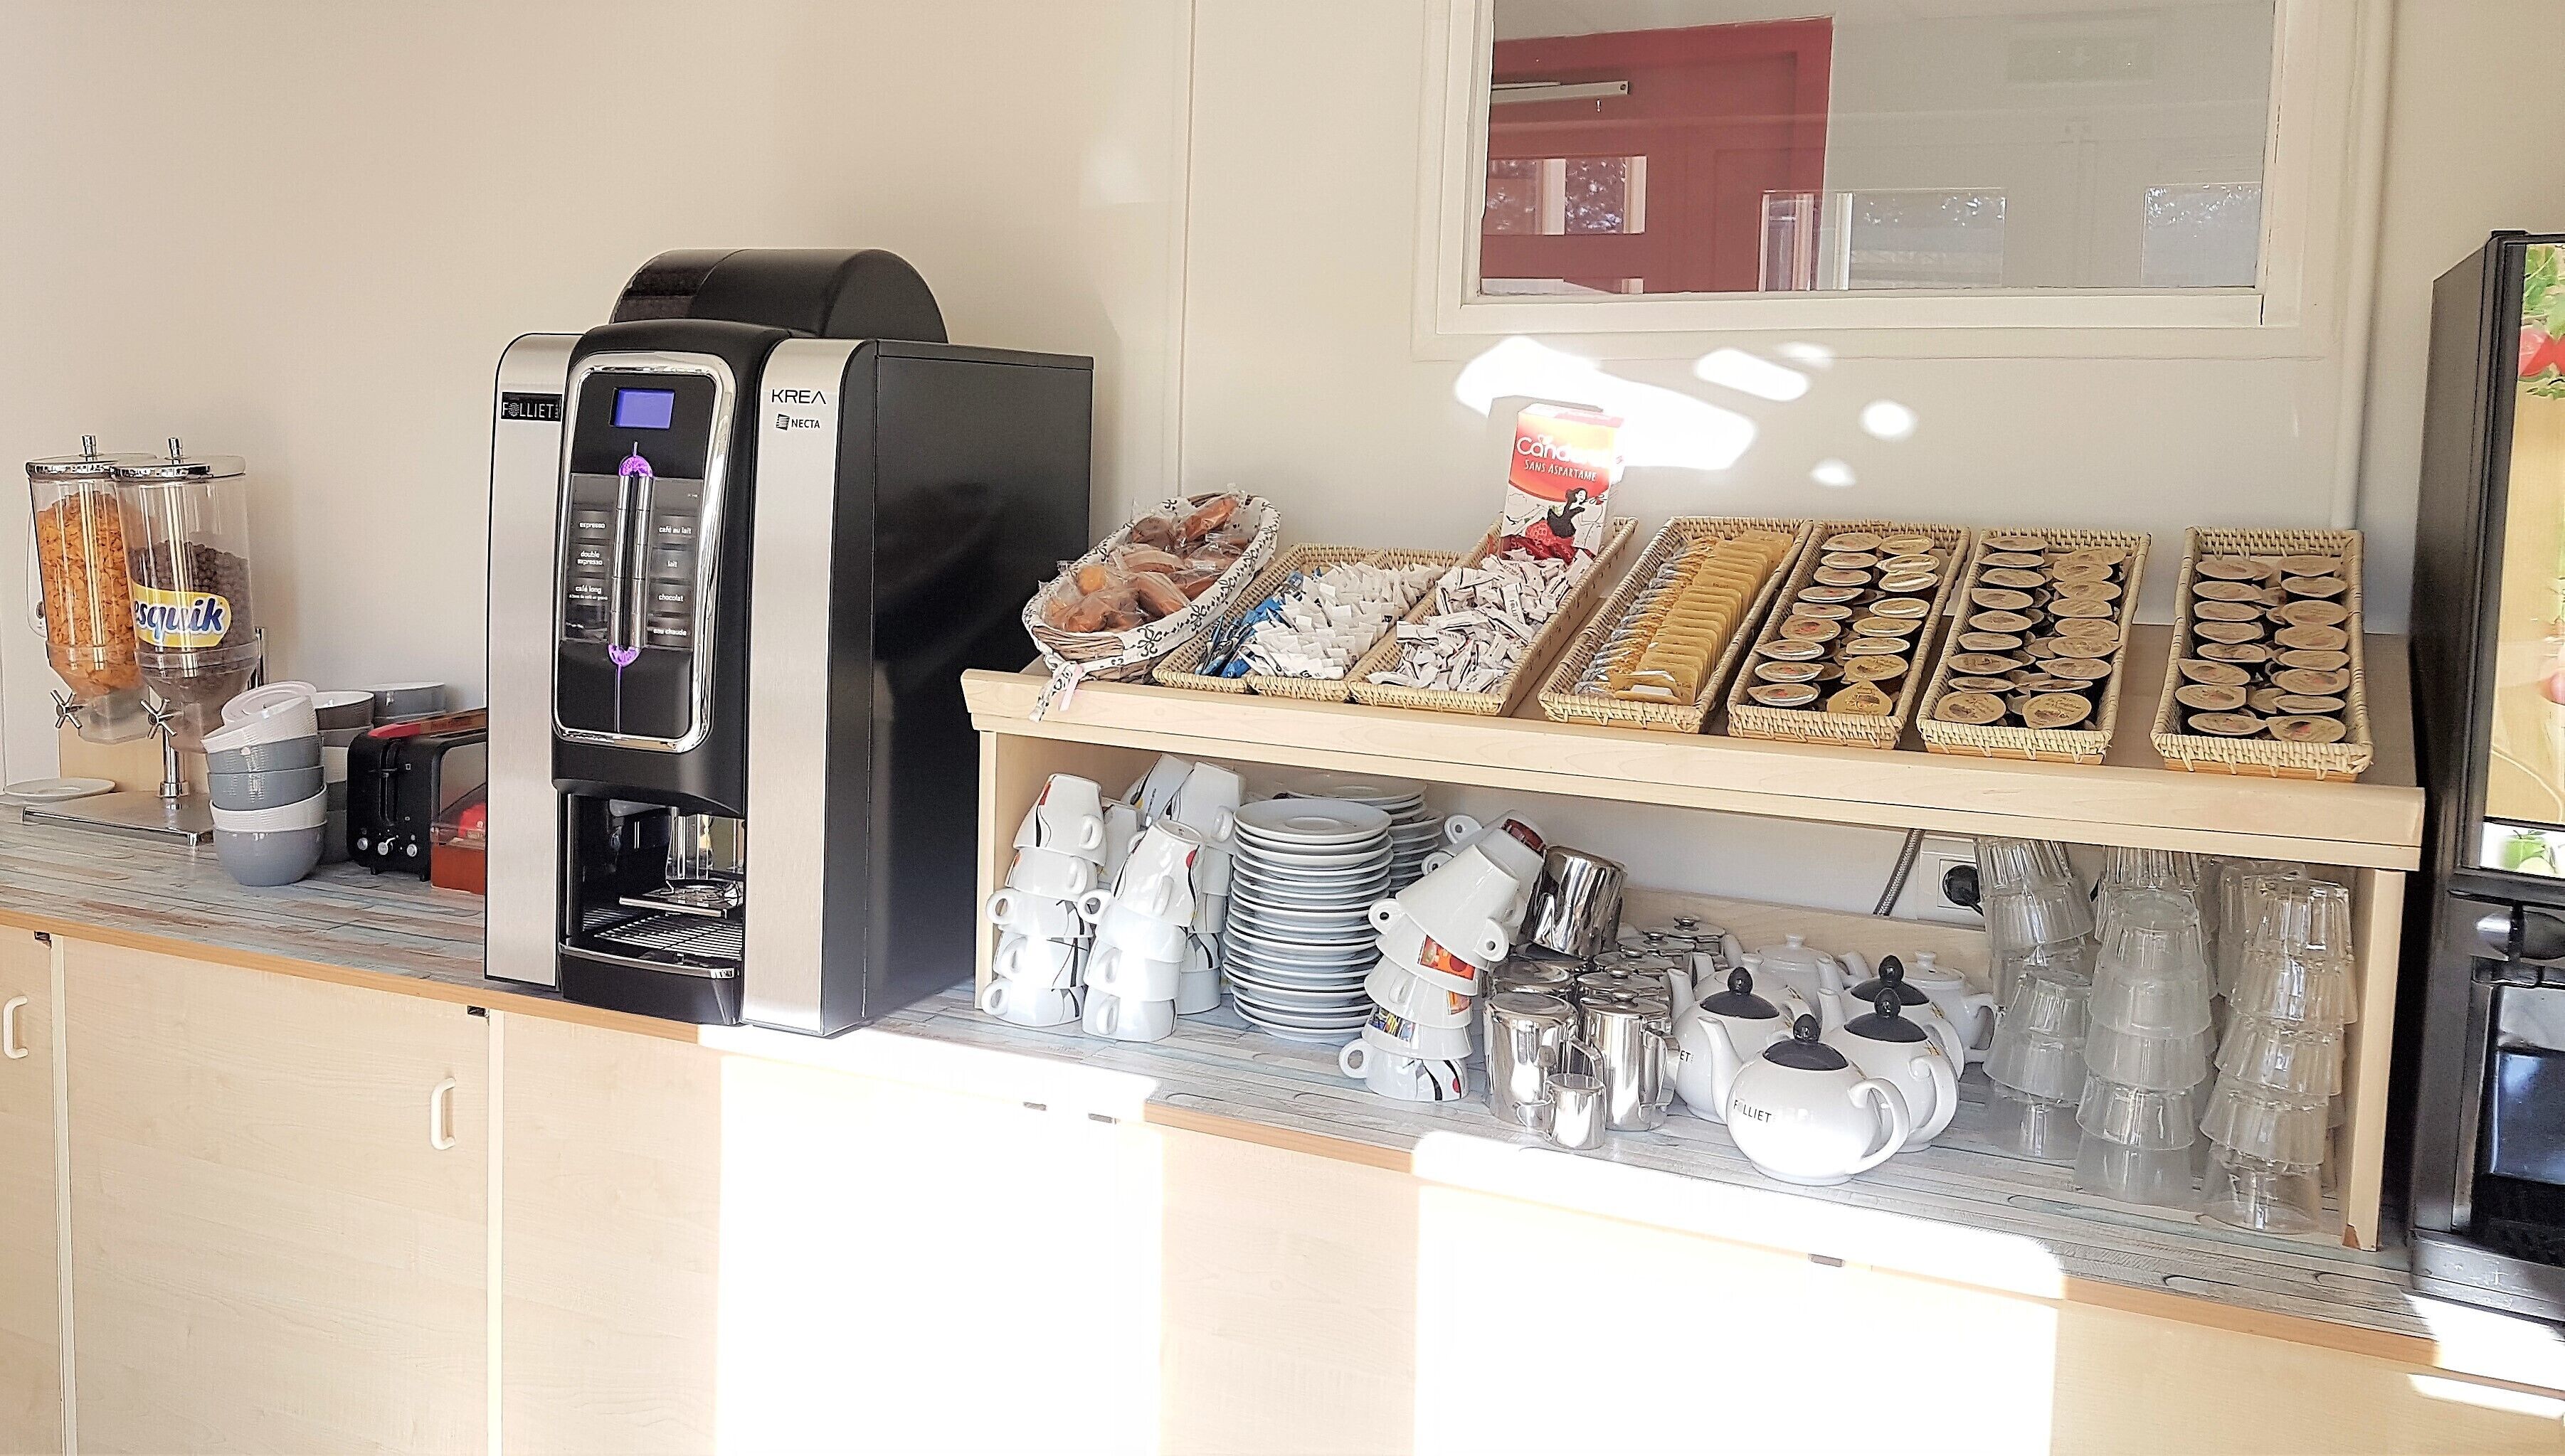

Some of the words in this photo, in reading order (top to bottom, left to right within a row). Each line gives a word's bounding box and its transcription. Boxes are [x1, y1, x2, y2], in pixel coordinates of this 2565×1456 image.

[771, 389, 827, 405] KREA
[502, 402, 554, 418] FOLLIET
[791, 419, 820, 428] NECTA
[1524, 459, 1546, 473] SANS
[1548, 463, 1597, 482] ASPARTAME
[134, 597, 223, 639] esquik
